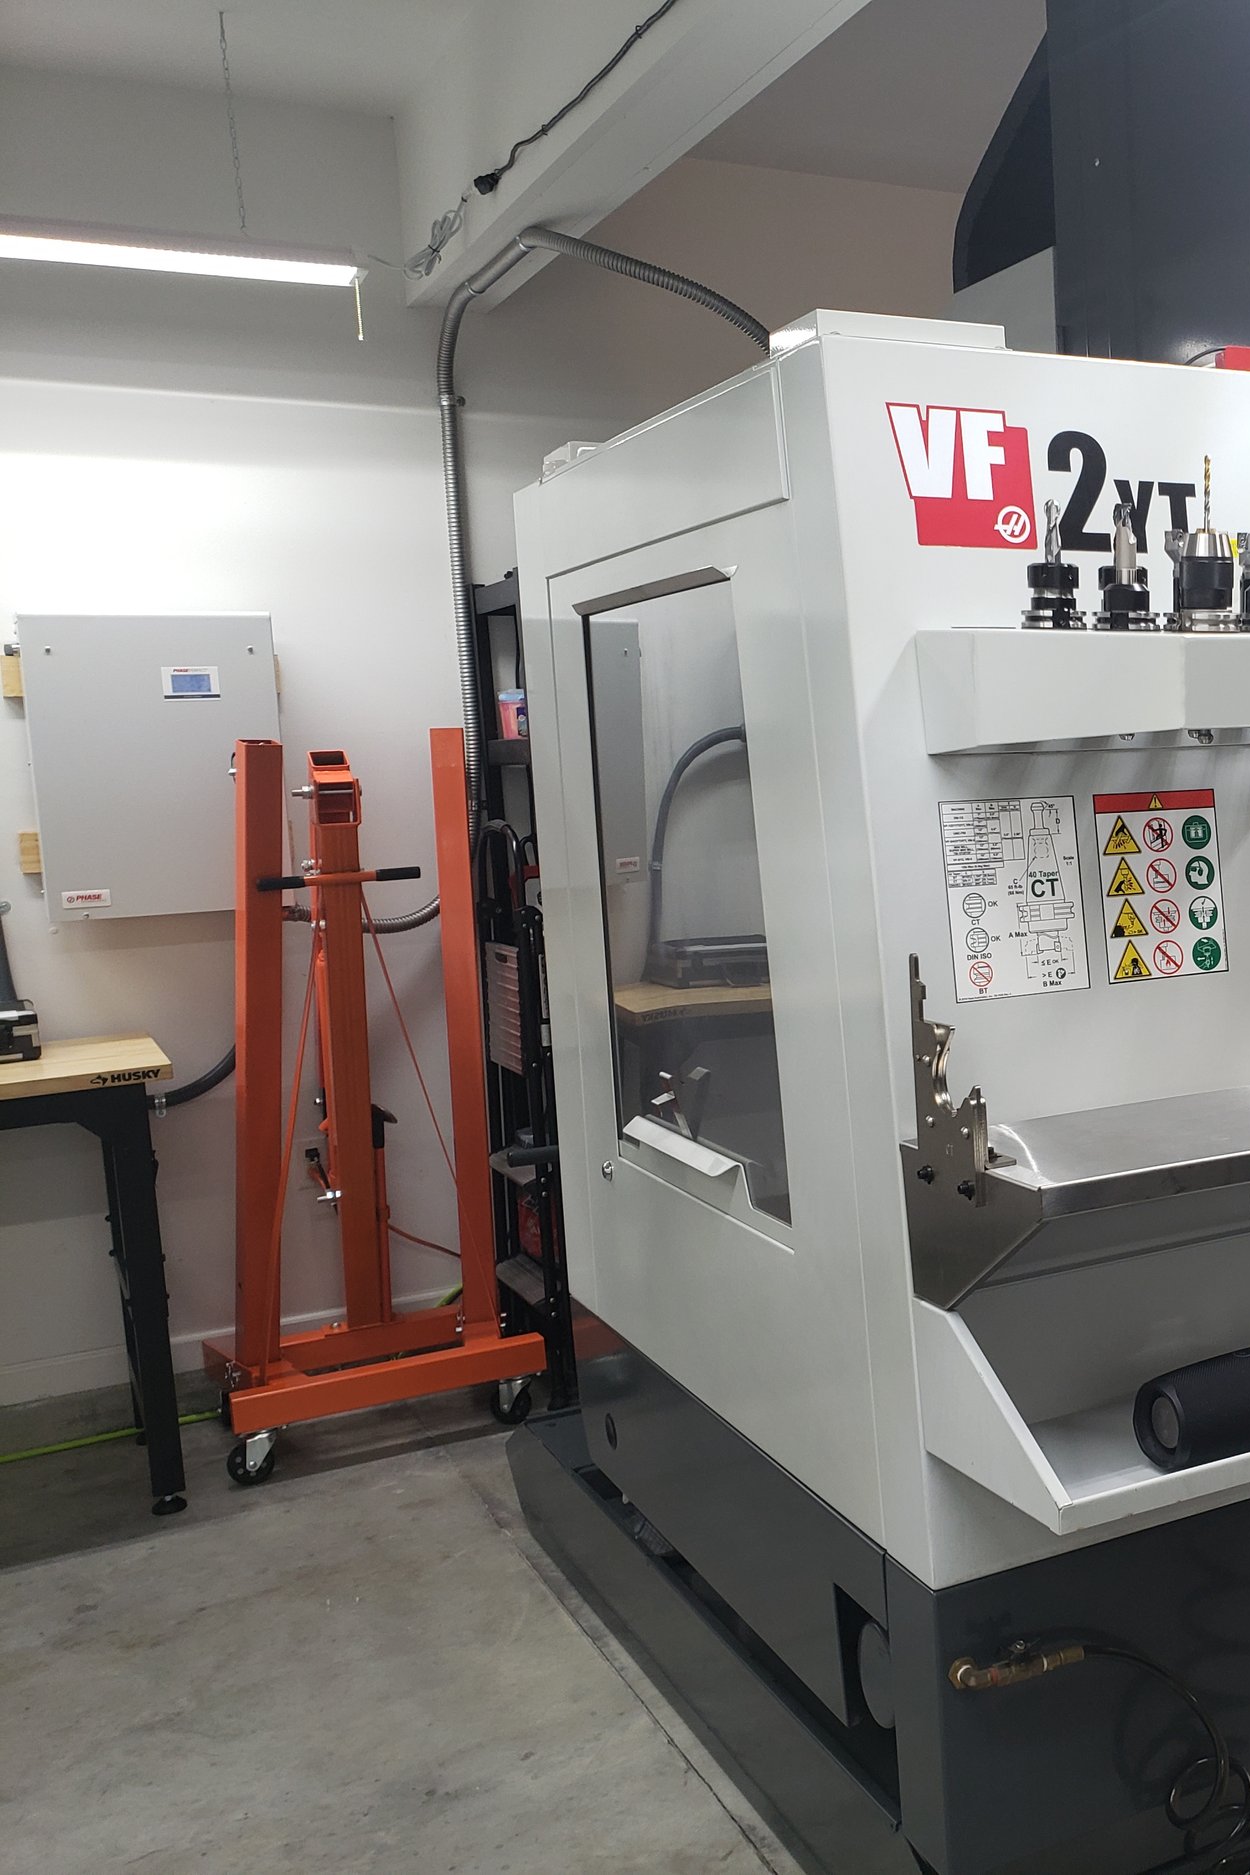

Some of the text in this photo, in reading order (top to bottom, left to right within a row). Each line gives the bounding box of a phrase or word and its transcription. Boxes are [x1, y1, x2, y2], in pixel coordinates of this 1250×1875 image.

[887, 403, 1006, 501] VF
[1038, 870, 1058, 878] Taper
[1031, 878, 1059, 898] CT
[110, 1069, 161, 1083] HUSKY
